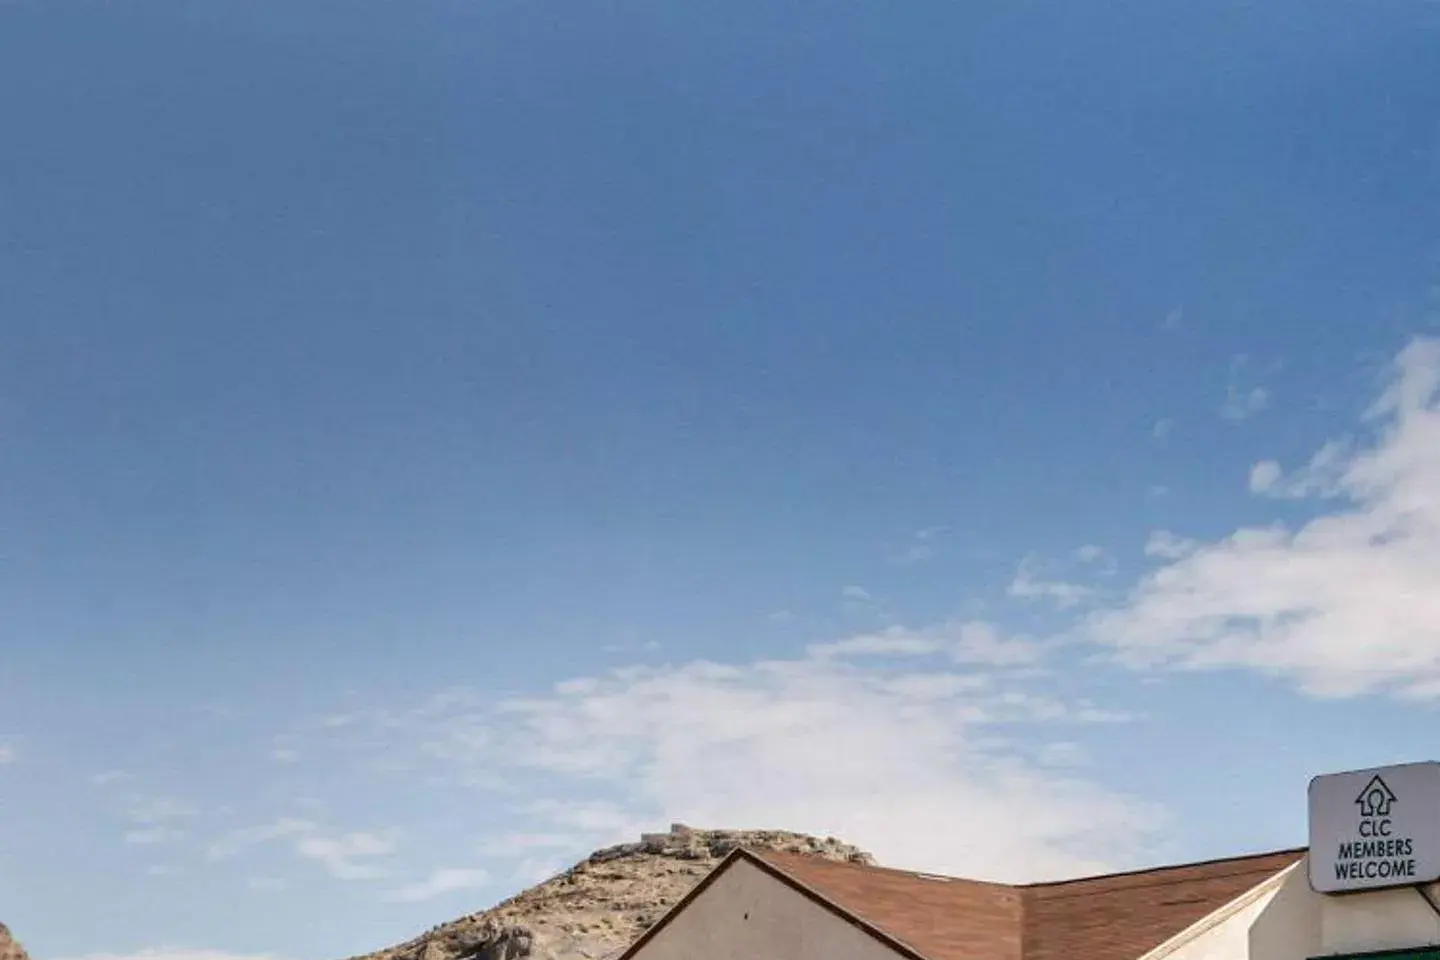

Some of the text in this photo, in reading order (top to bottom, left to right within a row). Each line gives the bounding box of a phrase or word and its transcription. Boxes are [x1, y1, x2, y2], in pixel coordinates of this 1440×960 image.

[1359, 819, 1392, 837] CLC
[1338, 839, 1413, 859] MEMBERS
[1335, 860, 1416, 880] WELCOME
